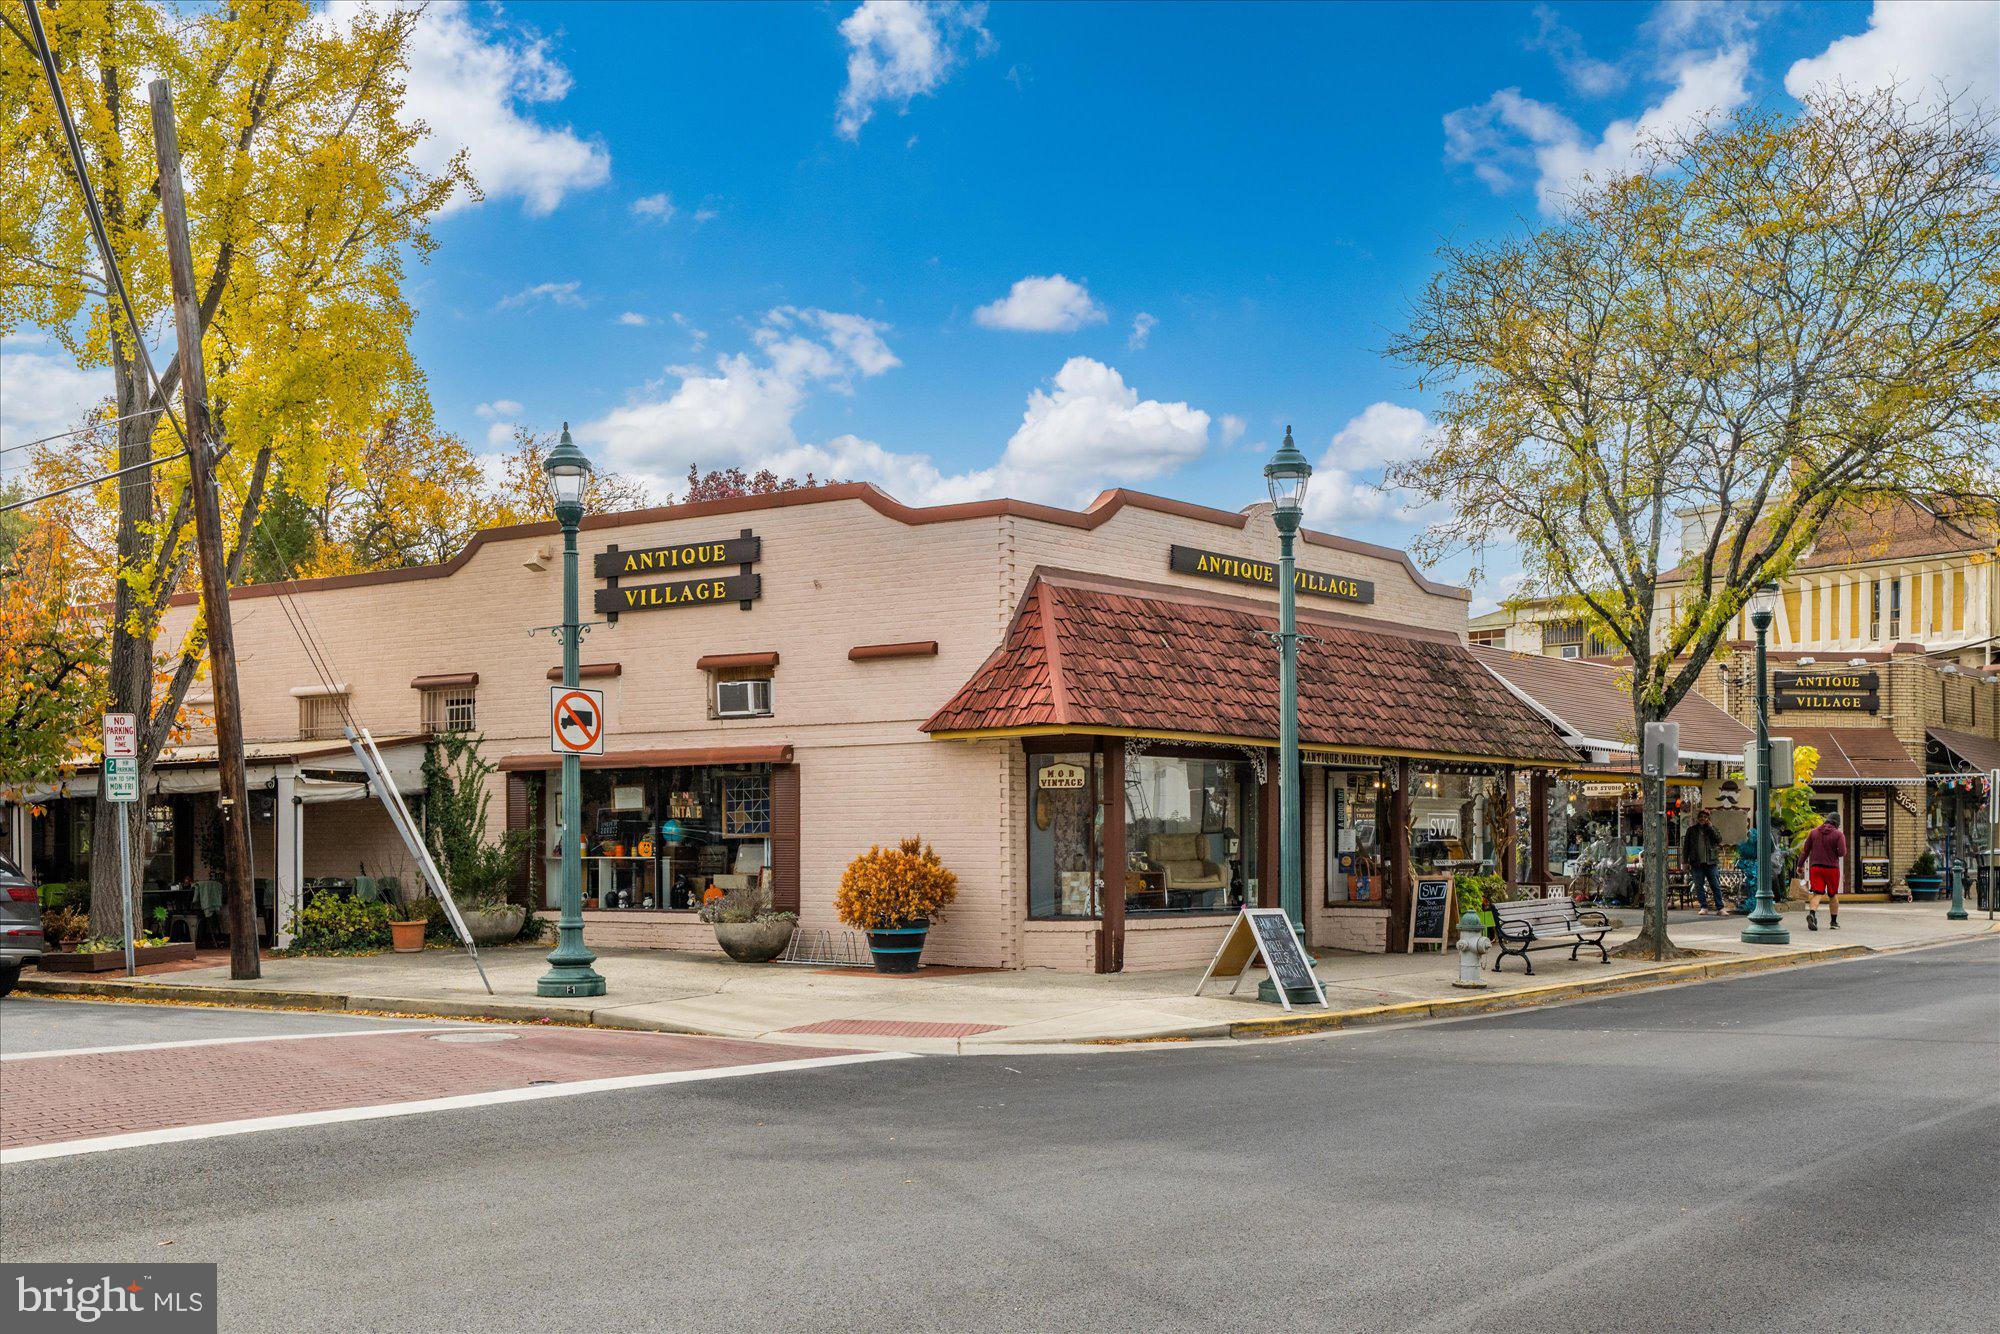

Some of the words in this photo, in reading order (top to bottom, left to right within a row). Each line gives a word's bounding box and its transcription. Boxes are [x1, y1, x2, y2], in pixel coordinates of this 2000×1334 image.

[624, 544, 726, 571] ANTIQUE
[1197, 554, 1273, 582] ANTIQUE
[625, 581, 726, 607] VILLAGE
[1795, 676, 1860, 687] ANTIQUE
[1796, 697, 1861, 708] VILLAGE
[114, 717, 126, 725] NO
[106, 727, 134, 735] PARKING
[1305, 751, 1339, 764] ANTIQUE
[109, 760, 115, 772] 2
[1040, 779, 1083, 787] VINTAGE
[1896, 790, 1917, 813] 3758
[1430, 818, 1456, 836] SW7
[1422, 884, 1447, 897] SW7
